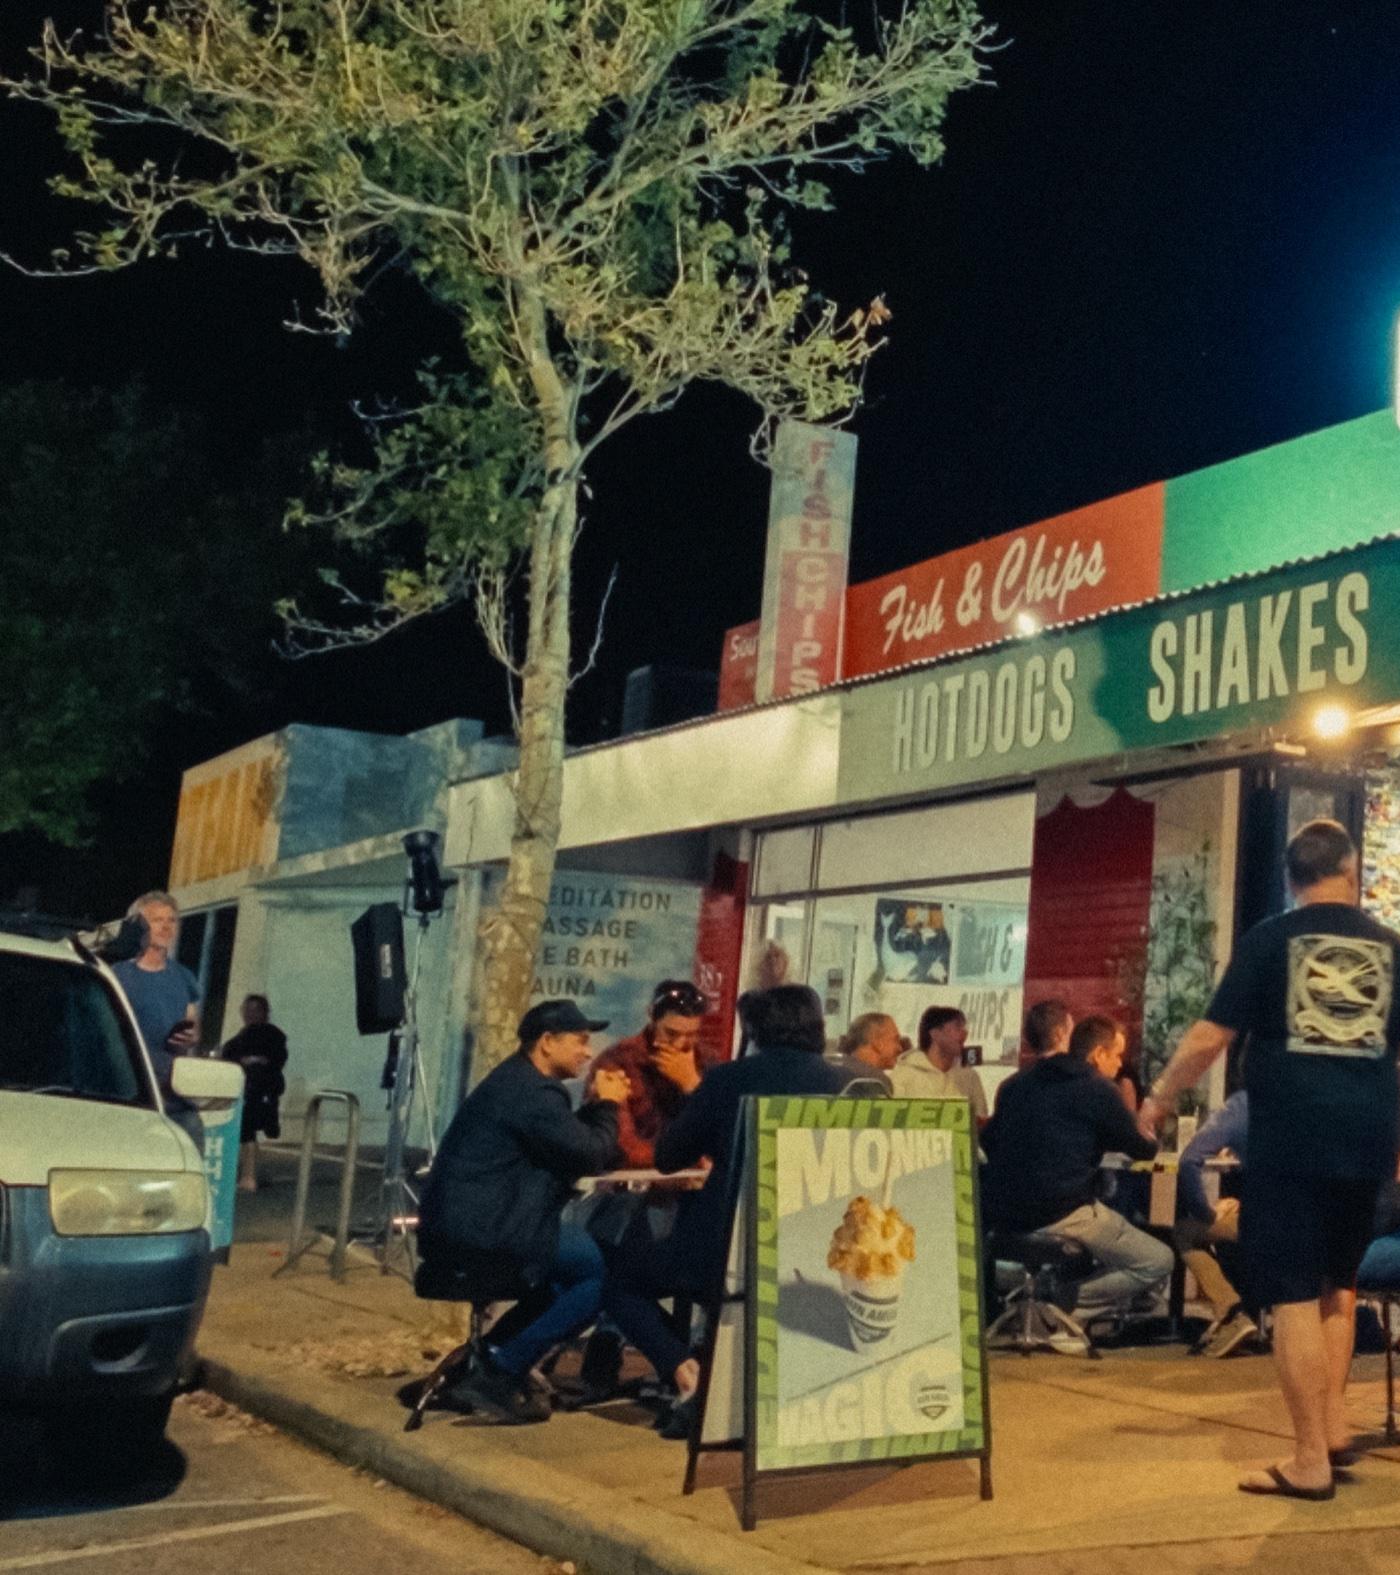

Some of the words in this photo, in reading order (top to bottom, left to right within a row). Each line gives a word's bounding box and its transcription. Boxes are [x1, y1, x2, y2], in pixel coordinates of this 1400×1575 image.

[801, 440, 835, 549] FISH
[789, 557, 829, 696] CHIPS
[879, 578, 945, 655] Fish
[956, 562, 983, 627] &
[991, 534, 1107, 623] Chips
[893, 647, 1075, 774] HOTDOGS
[1147, 571, 1370, 724] SHAKES
[542, 916, 638, 939] ASSAGE
[565, 946, 629, 968] BATH
[533, 975, 596, 996] AUNA
[759, 1098, 969, 1130] LIMITED
